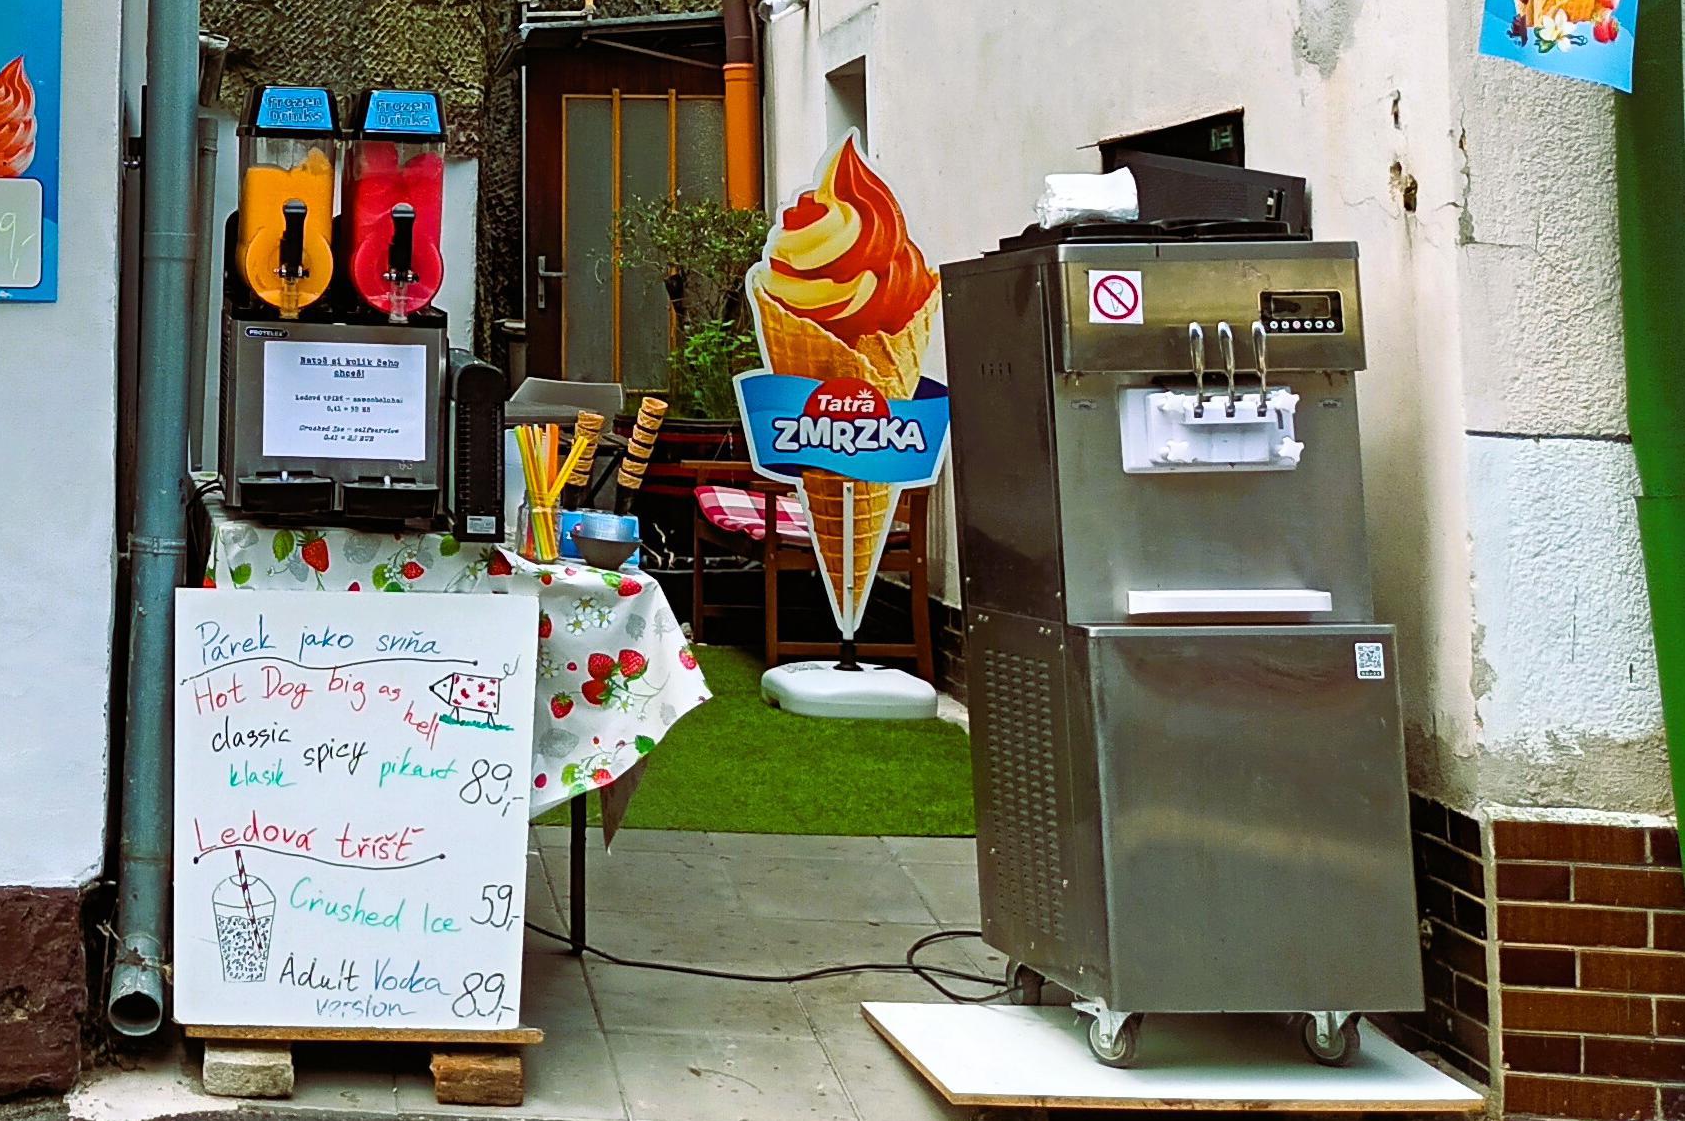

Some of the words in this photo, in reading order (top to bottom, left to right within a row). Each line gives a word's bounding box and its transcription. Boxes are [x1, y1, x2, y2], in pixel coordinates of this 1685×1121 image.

[268, 96, 322, 108] Frozen
[269, 108, 324, 122] Drinks
[377, 100, 432, 112] Frozen
[379, 113, 432, 126] Drinks
[817, 394, 876, 413] Tatra
[774, 415, 926, 454] ZMRZKA
[195, 614, 276, 665] Párek
[298, 626, 354, 661] jako
[194, 673, 246, 715] Hot
[261, 665, 313, 710] Dog
[328, 666, 368, 712] big
[379, 685, 402, 702] as
[212, 716, 292, 752] classic
[403, 700, 440, 751] hell
[230, 758, 300, 788] klasik
[303, 739, 369, 775] spicy
[194, 809, 318, 852] Ledová
[335, 822, 425, 862] tříšť
[289, 876, 402, 931] Crushed
[423, 903, 462, 934] Ice
[278, 951, 360, 993] Adult
[374, 957, 452, 996] Vodka
[315, 995, 416, 1019] version
